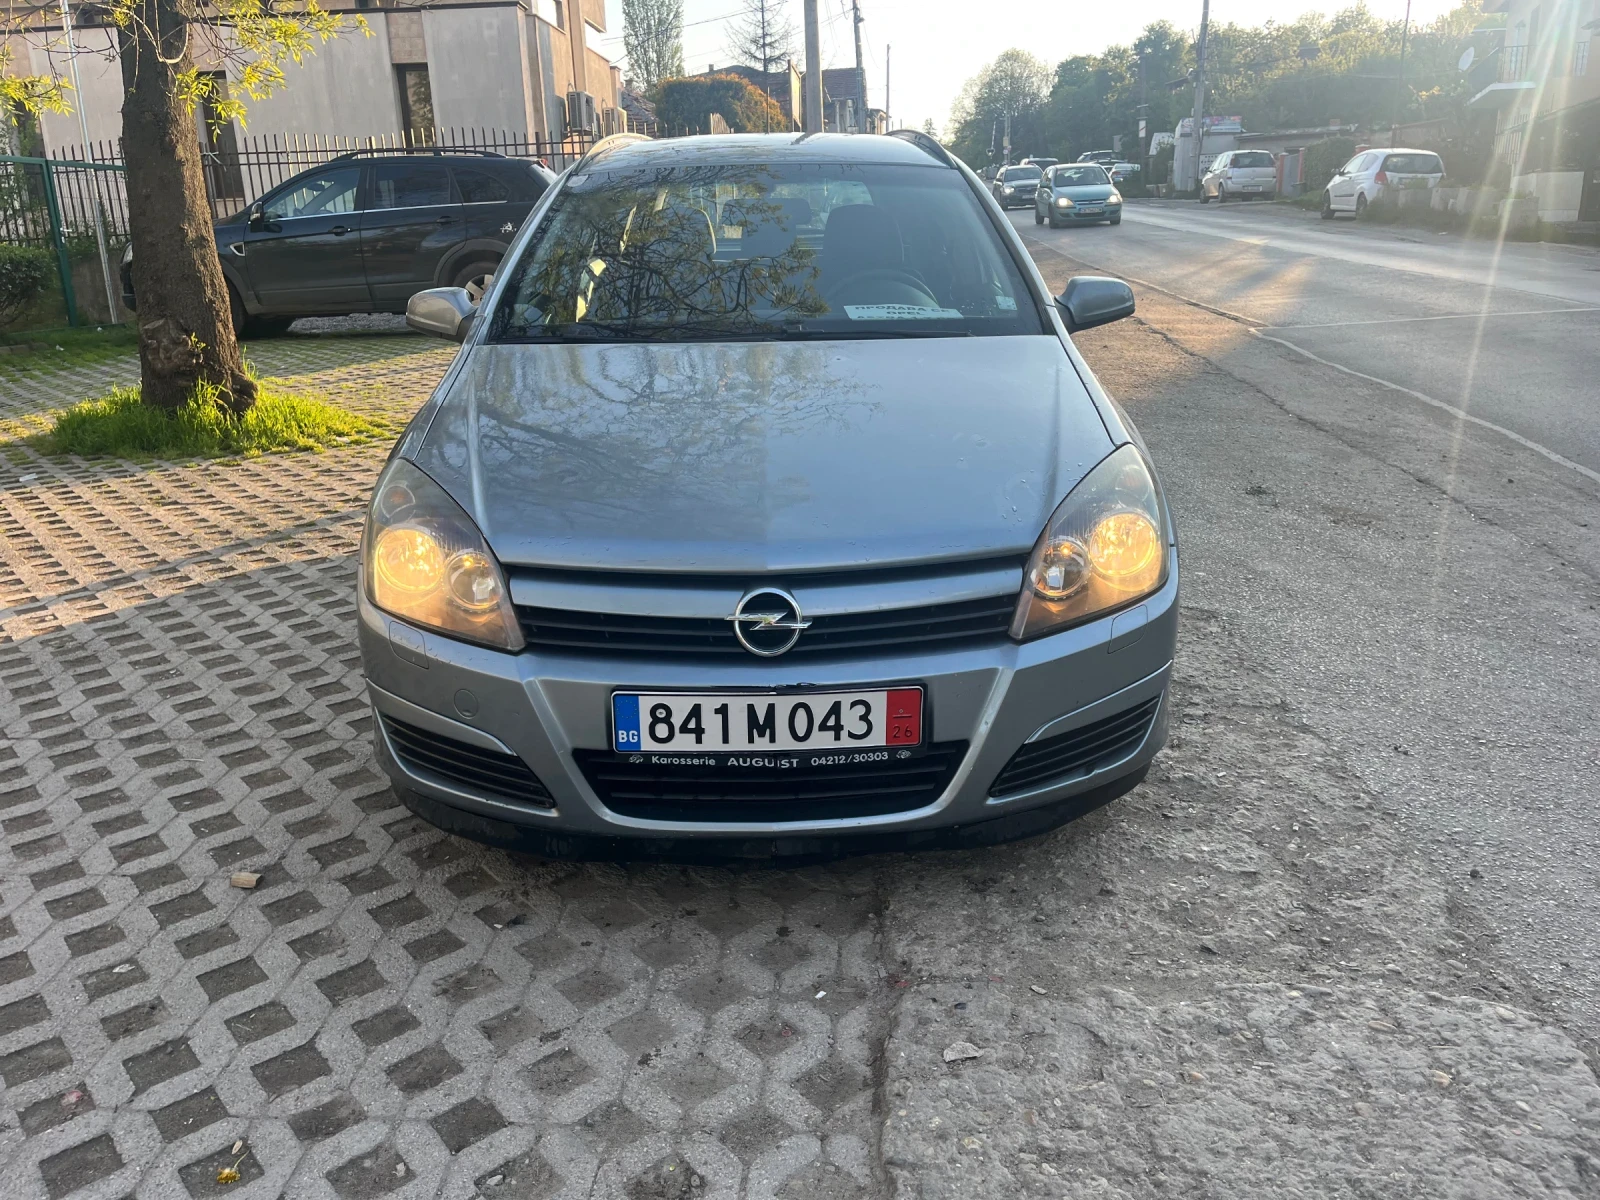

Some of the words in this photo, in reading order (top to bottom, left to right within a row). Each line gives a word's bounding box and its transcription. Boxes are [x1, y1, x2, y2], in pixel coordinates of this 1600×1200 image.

[648, 702, 730, 745] 841
[746, 703, 777, 744] M
[788, 699, 874, 743] 043
[618, 730, 639, 743] BG
[892, 725, 913, 739] 26
[651, 755, 716, 766] Karosserie
[727, 757, 800, 769] AUGUST
[811, 751, 889, 766] 04212/30303
